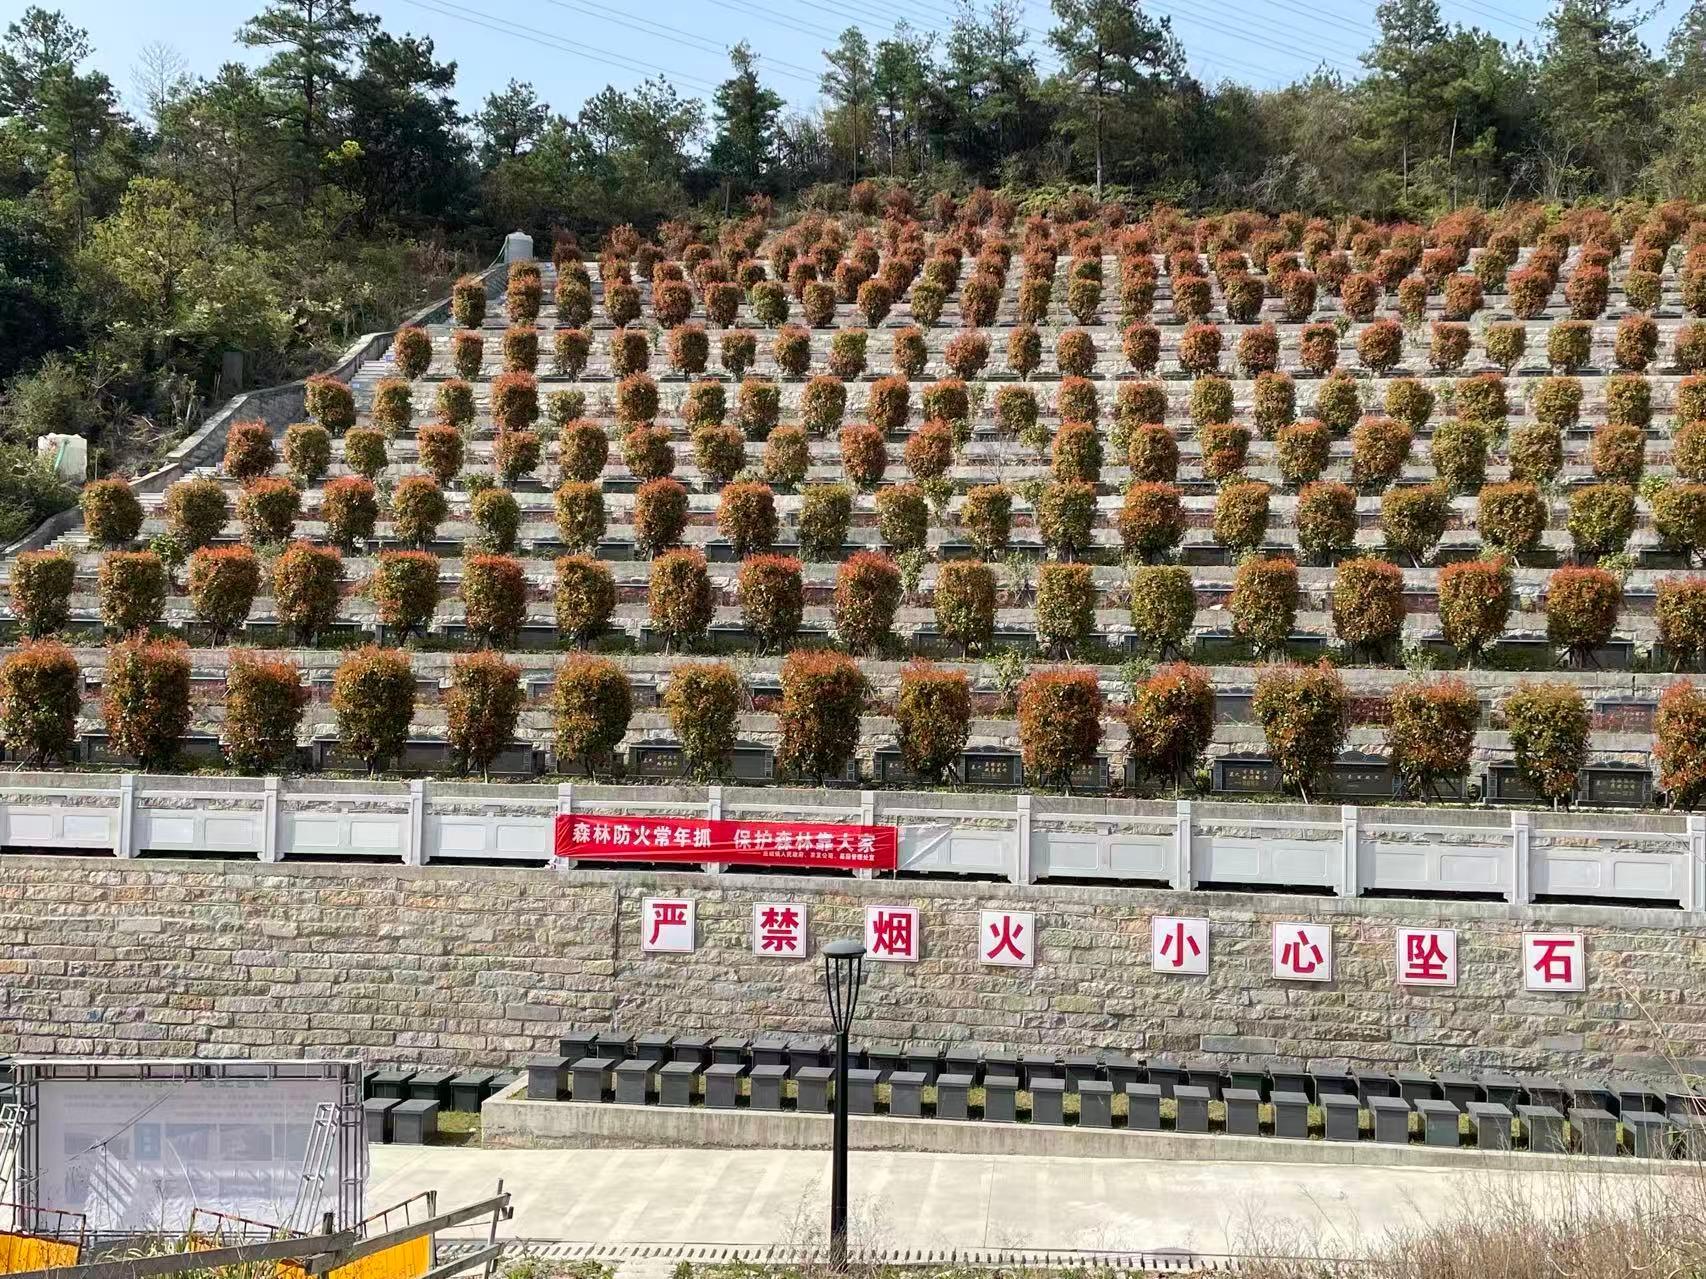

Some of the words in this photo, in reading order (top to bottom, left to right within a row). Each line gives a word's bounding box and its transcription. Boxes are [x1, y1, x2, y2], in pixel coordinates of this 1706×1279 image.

[572, 821, 712, 848] 森林防火常年抓
[733, 828, 876, 853] 保护森林靠大家
[648, 903, 1025, 959] 严禁烟火
[1160, 923, 1574, 982] 小心坠石
